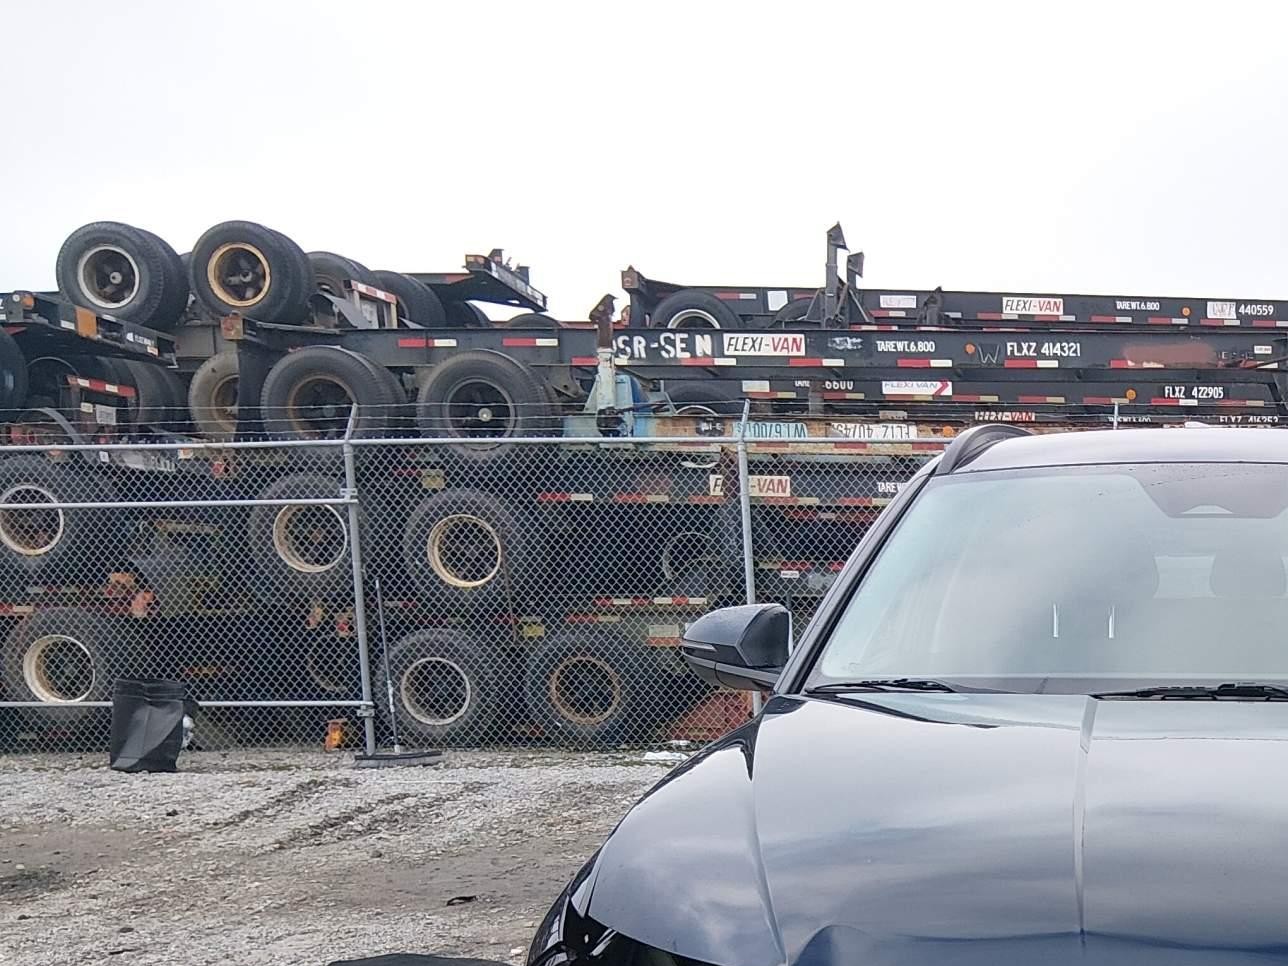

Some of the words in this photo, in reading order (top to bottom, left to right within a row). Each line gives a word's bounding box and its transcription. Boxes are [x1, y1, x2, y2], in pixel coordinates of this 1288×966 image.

[1005, 299, 1061, 312] FLEXI-VAN
[1238, 303, 1274, 316] 440559
[727, 336, 803, 353] FLEXI-VAN
[1006, 342, 1038, 356] FLXZ
[1040, 342, 1081, 356] 414321
[1164, 385, 1186, 398] FLXZ
[1191, 386, 1224, 399] 422905
